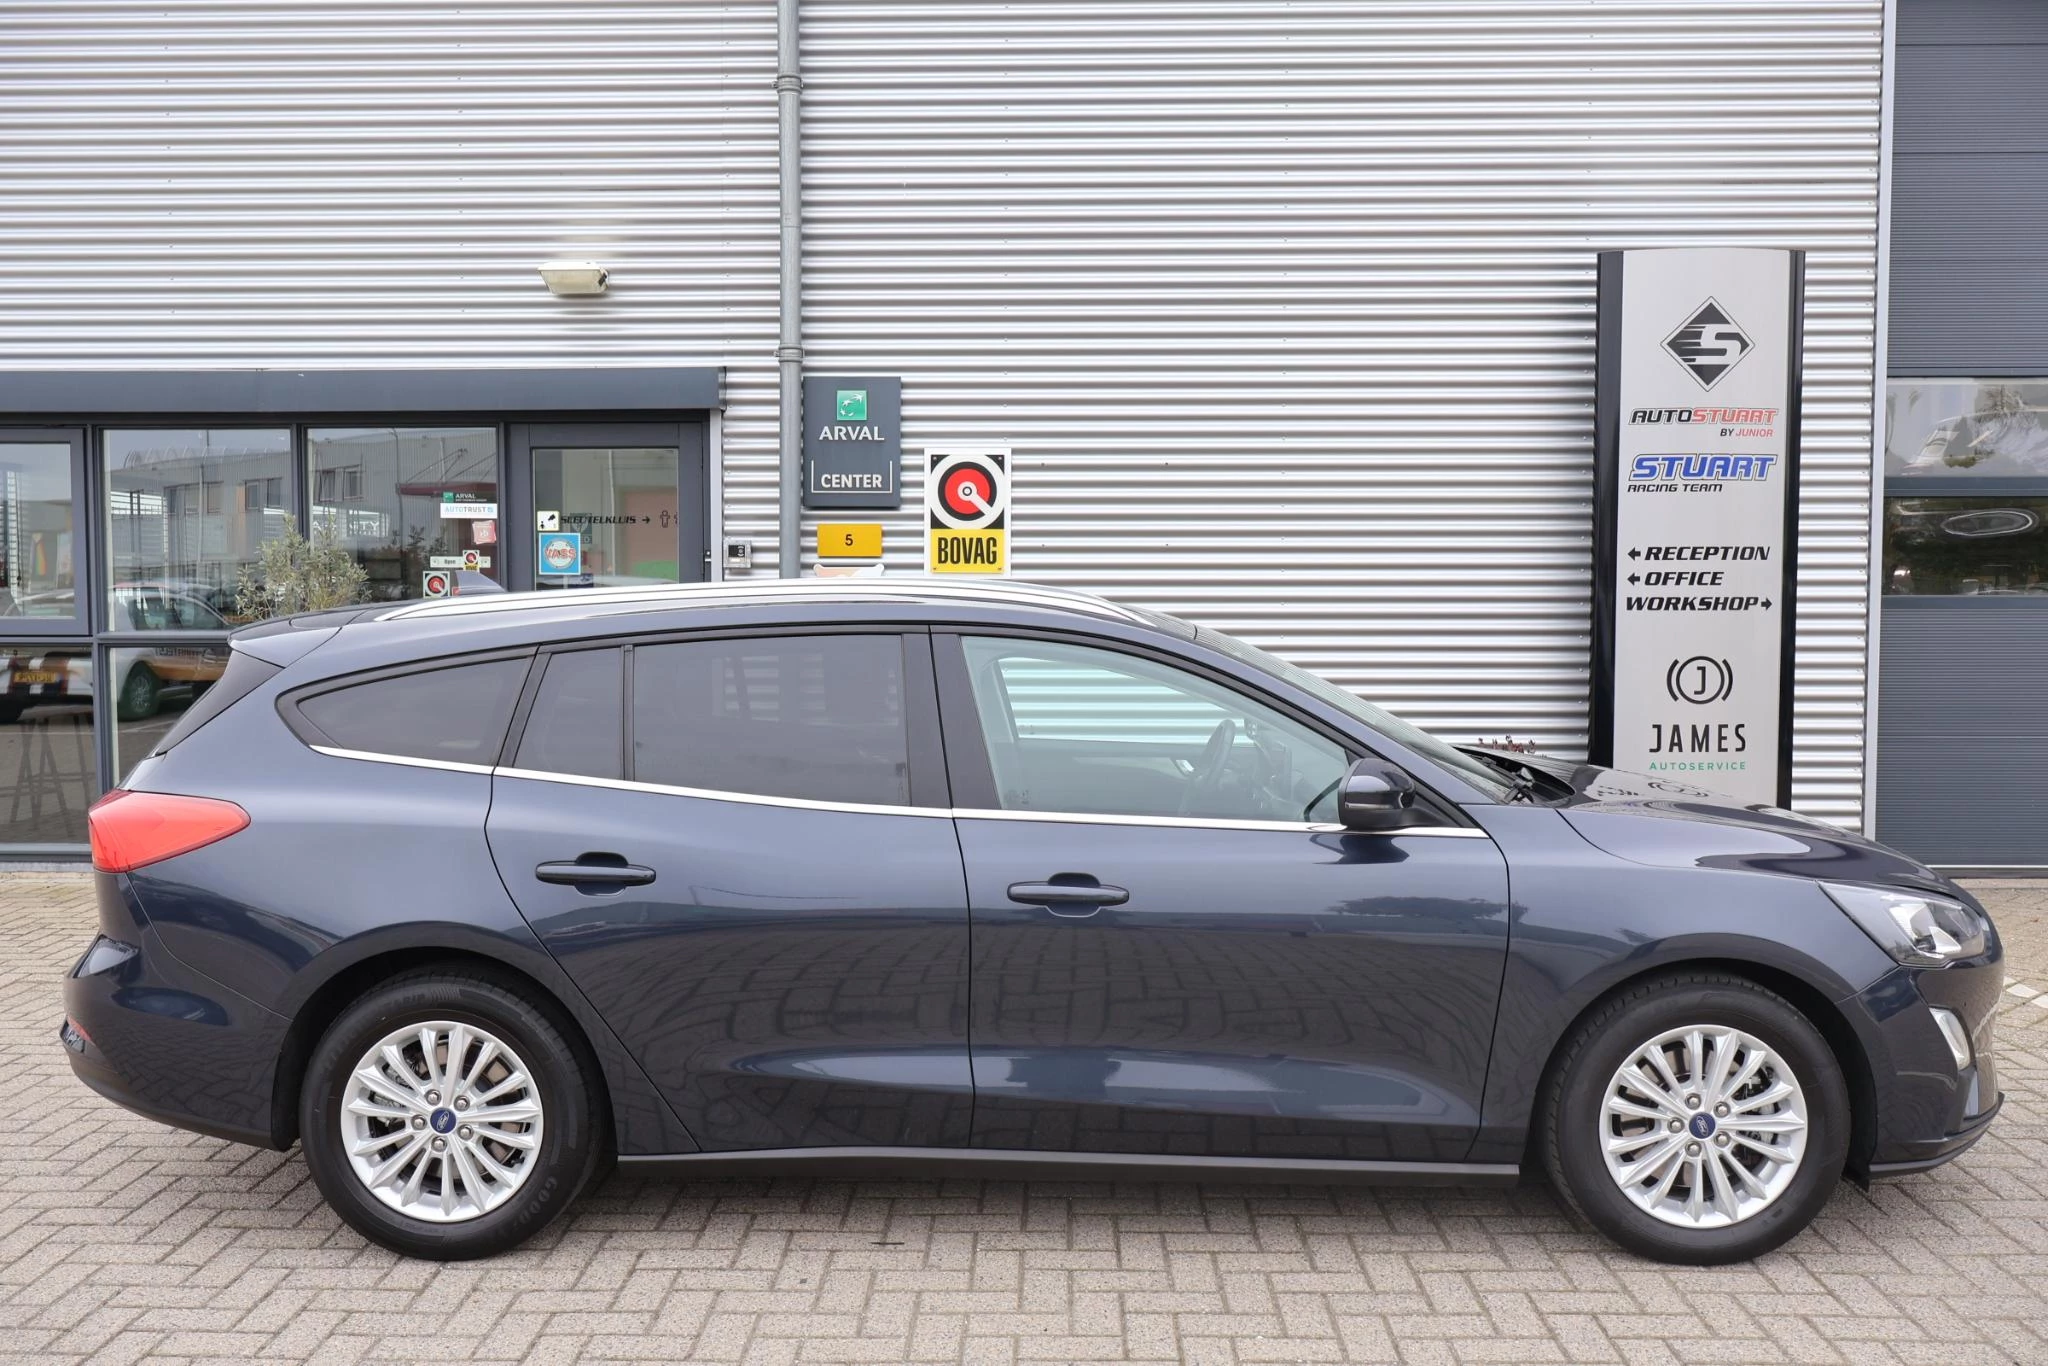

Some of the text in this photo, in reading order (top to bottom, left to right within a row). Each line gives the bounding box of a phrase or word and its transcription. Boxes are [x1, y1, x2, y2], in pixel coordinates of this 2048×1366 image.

[1629, 408, 1778, 425] AUTOSTUART
[819, 426, 885, 441] ARVAL
[1720, 428, 1773, 437] BY JUNIOR
[1629, 454, 1778, 481] STUART
[821, 474, 883, 489] CENTER
[1627, 484, 1723, 493] RACING TEAM
[844, 533, 854, 546] 5
[937, 536, 998, 565] BOVAG
[1644, 546, 1771, 561] RECEPTION
[1644, 571, 1725, 586] OFFICE
[1626, 596, 1759, 611] WORKSHOP
[1649, 723, 1747, 753] JAMES
[1649, 761, 1746, 771] AUTOSERVICE
